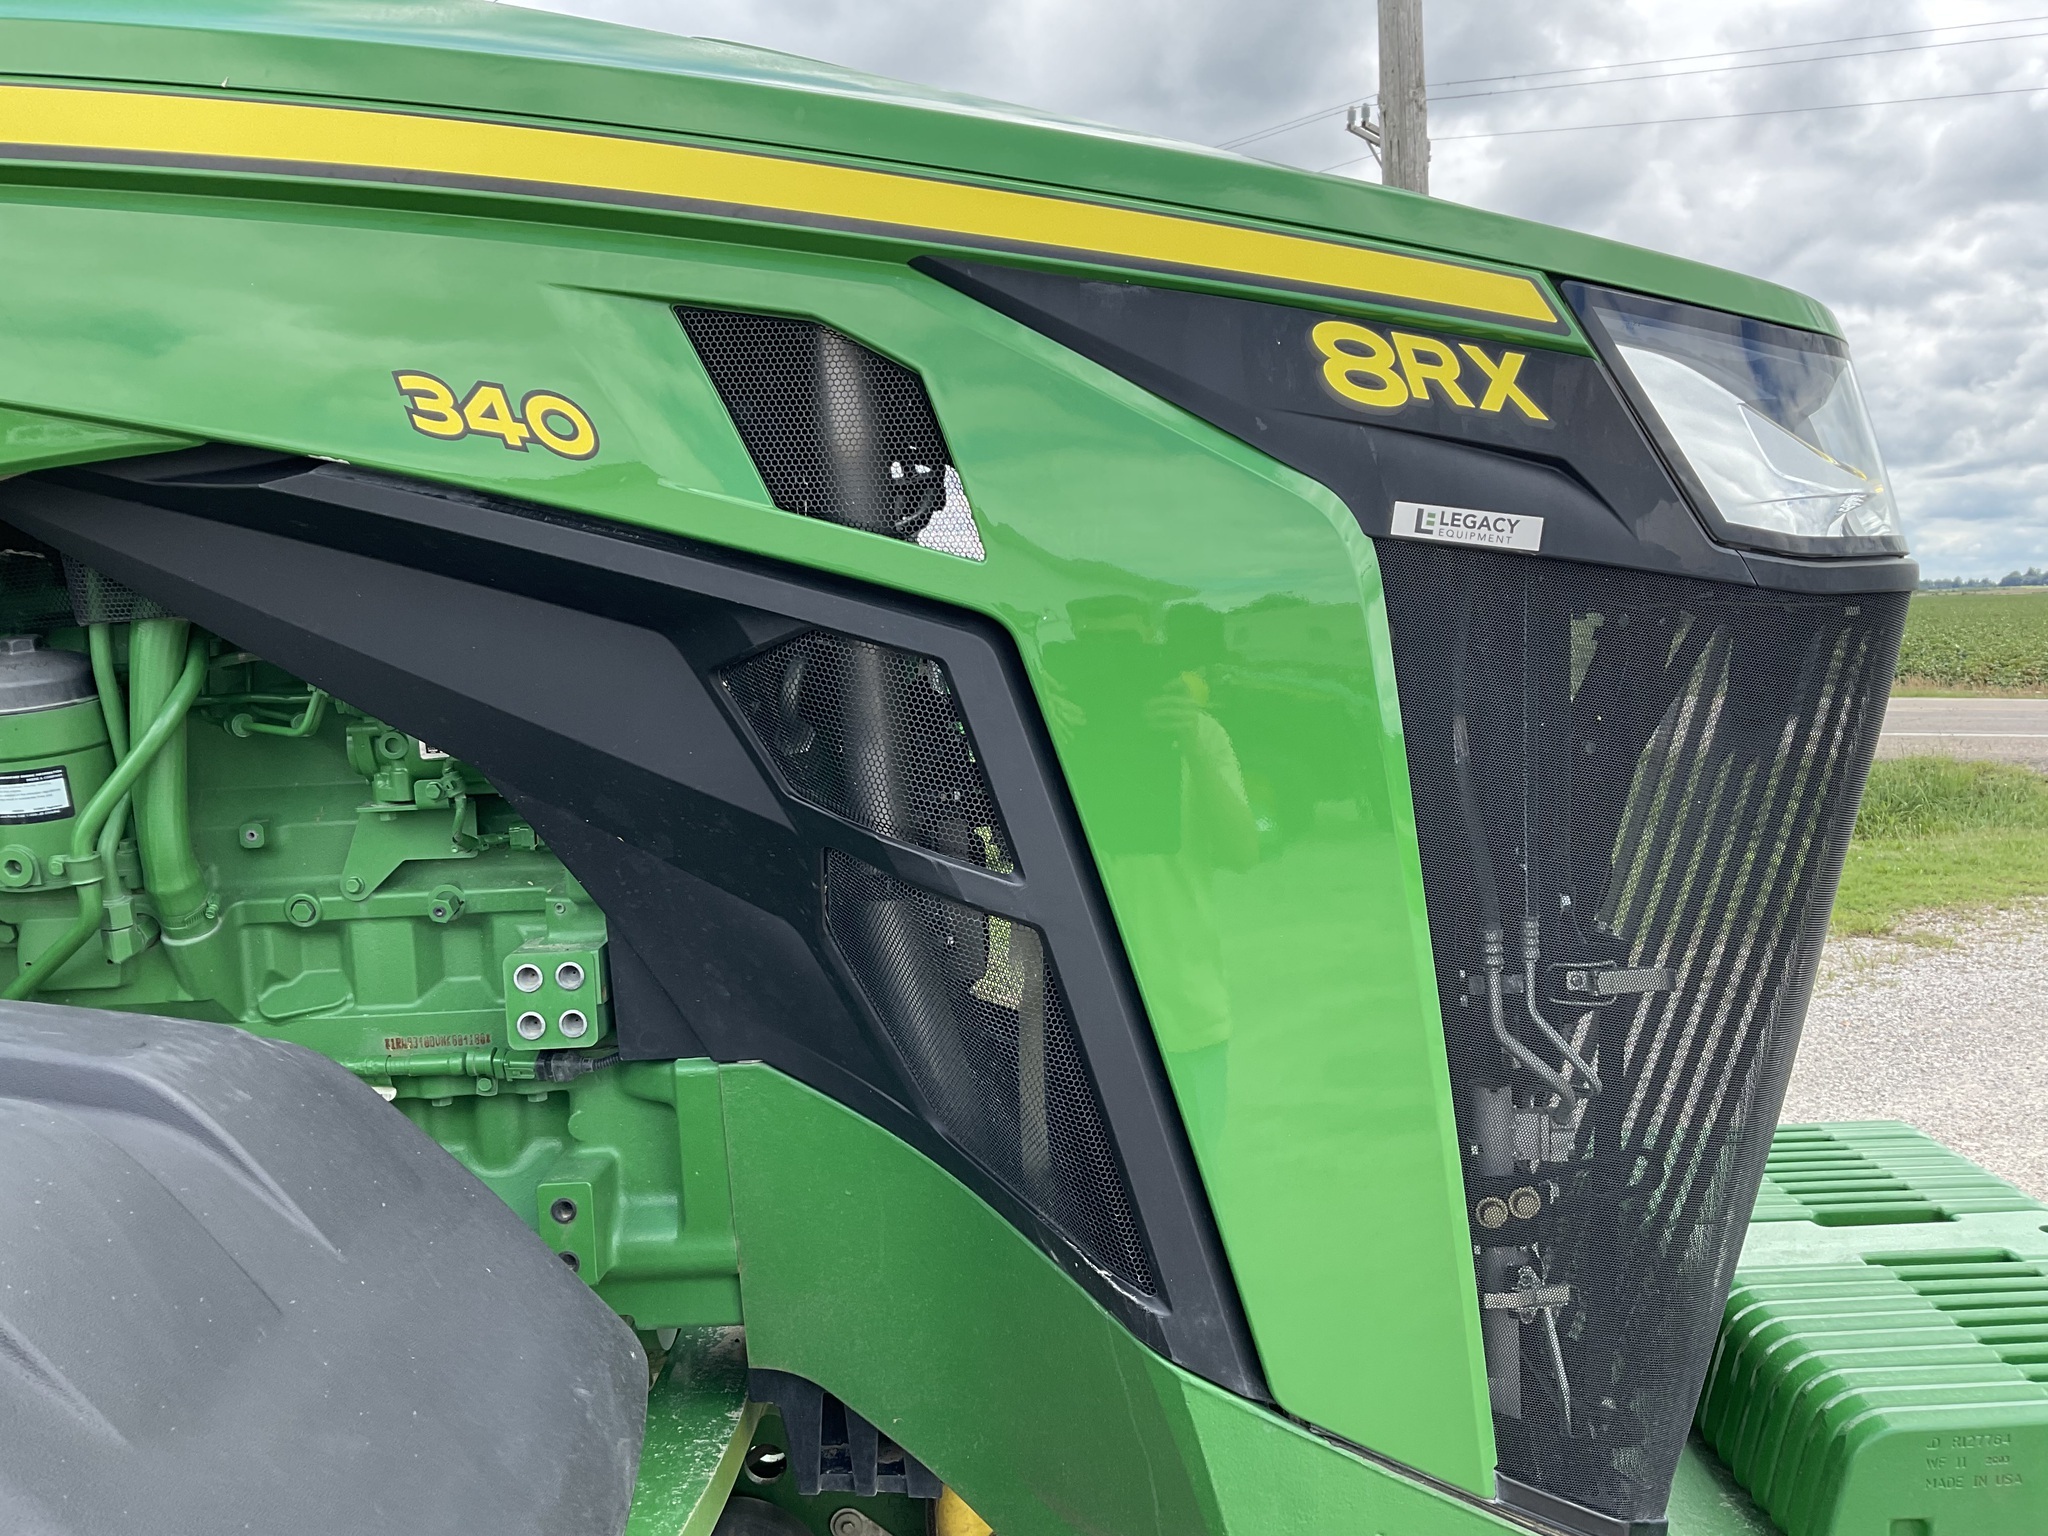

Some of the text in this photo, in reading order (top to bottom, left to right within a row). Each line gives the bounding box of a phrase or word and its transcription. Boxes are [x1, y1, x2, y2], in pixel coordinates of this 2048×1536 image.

[1312, 320, 1550, 422] 8RX
[393, 370, 599, 460] 340
[1440, 510, 1520, 534] LEGACY
[1438, 528, 1513, 545] EQUIPMENT
[1925, 1473, 2023, 1491] MADE IN USA
